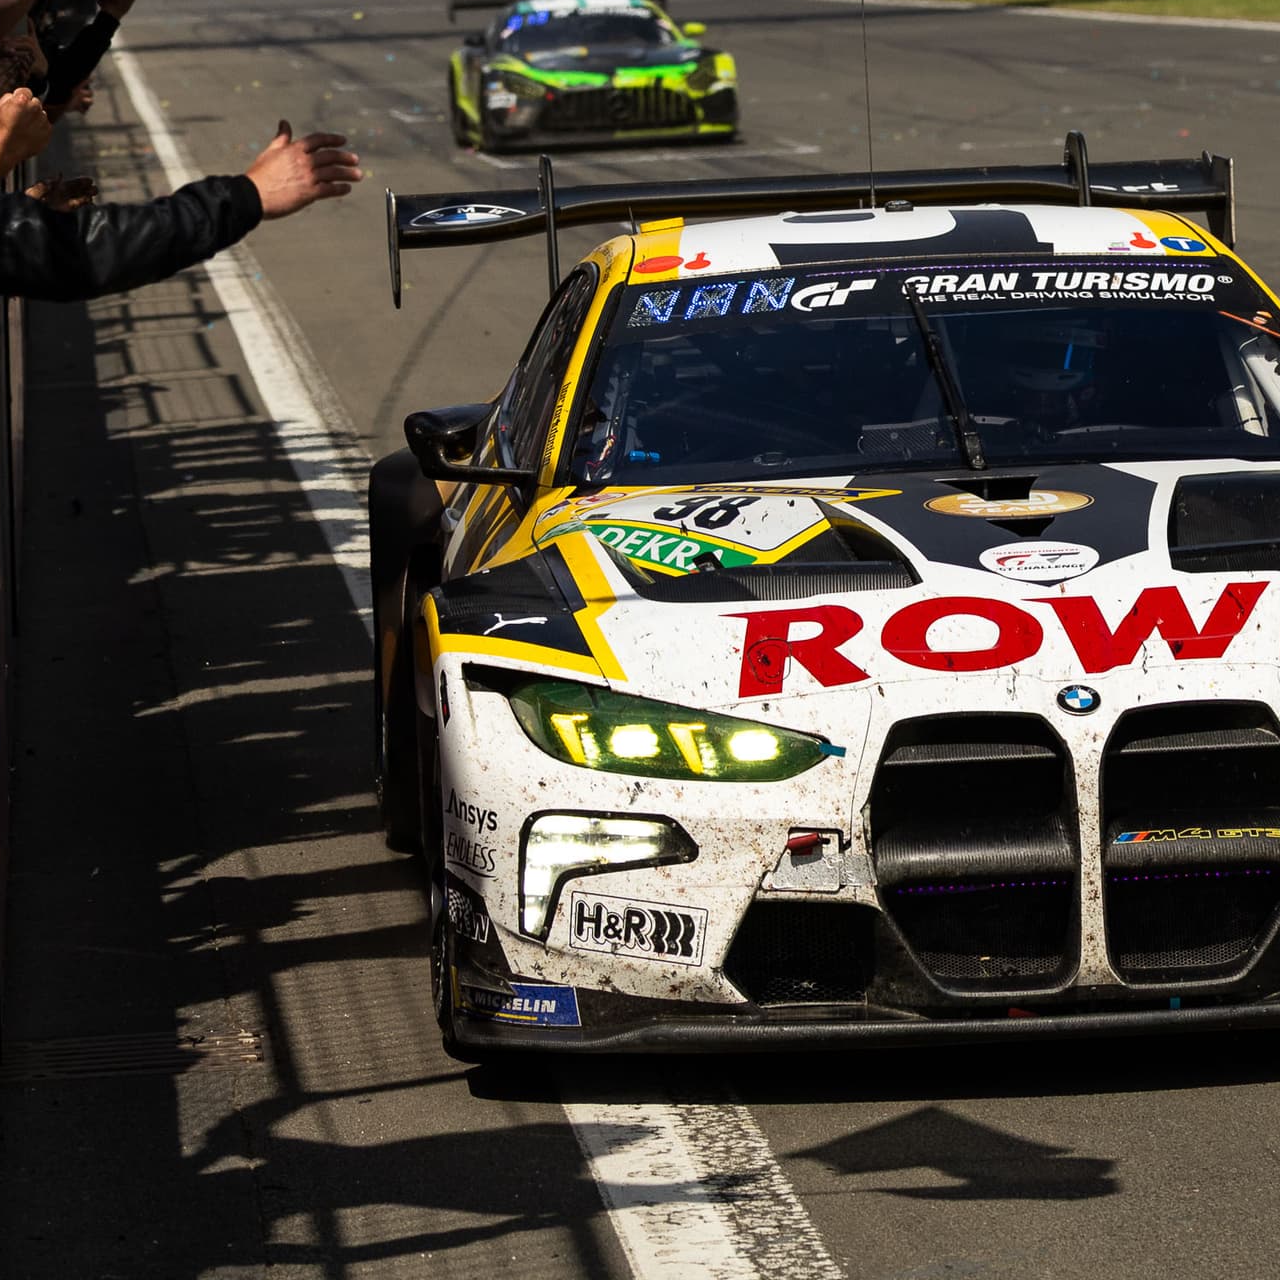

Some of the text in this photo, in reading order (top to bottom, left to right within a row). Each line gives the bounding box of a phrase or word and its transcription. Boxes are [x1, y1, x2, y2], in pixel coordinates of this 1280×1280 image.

[902, 272, 1019, 295] GRAN
[906, 291, 1216, 304] HE REAL DRIVING SIMULATOR
[653, 495, 762, 531] 98
[598, 526, 723, 571] DEKR
[1017, 563, 1086, 571] CHALLENGE
[445, 788, 498, 834] Ansys
[447, 831, 497, 872] ENDLESS
[574, 901, 652, 951] H&R
